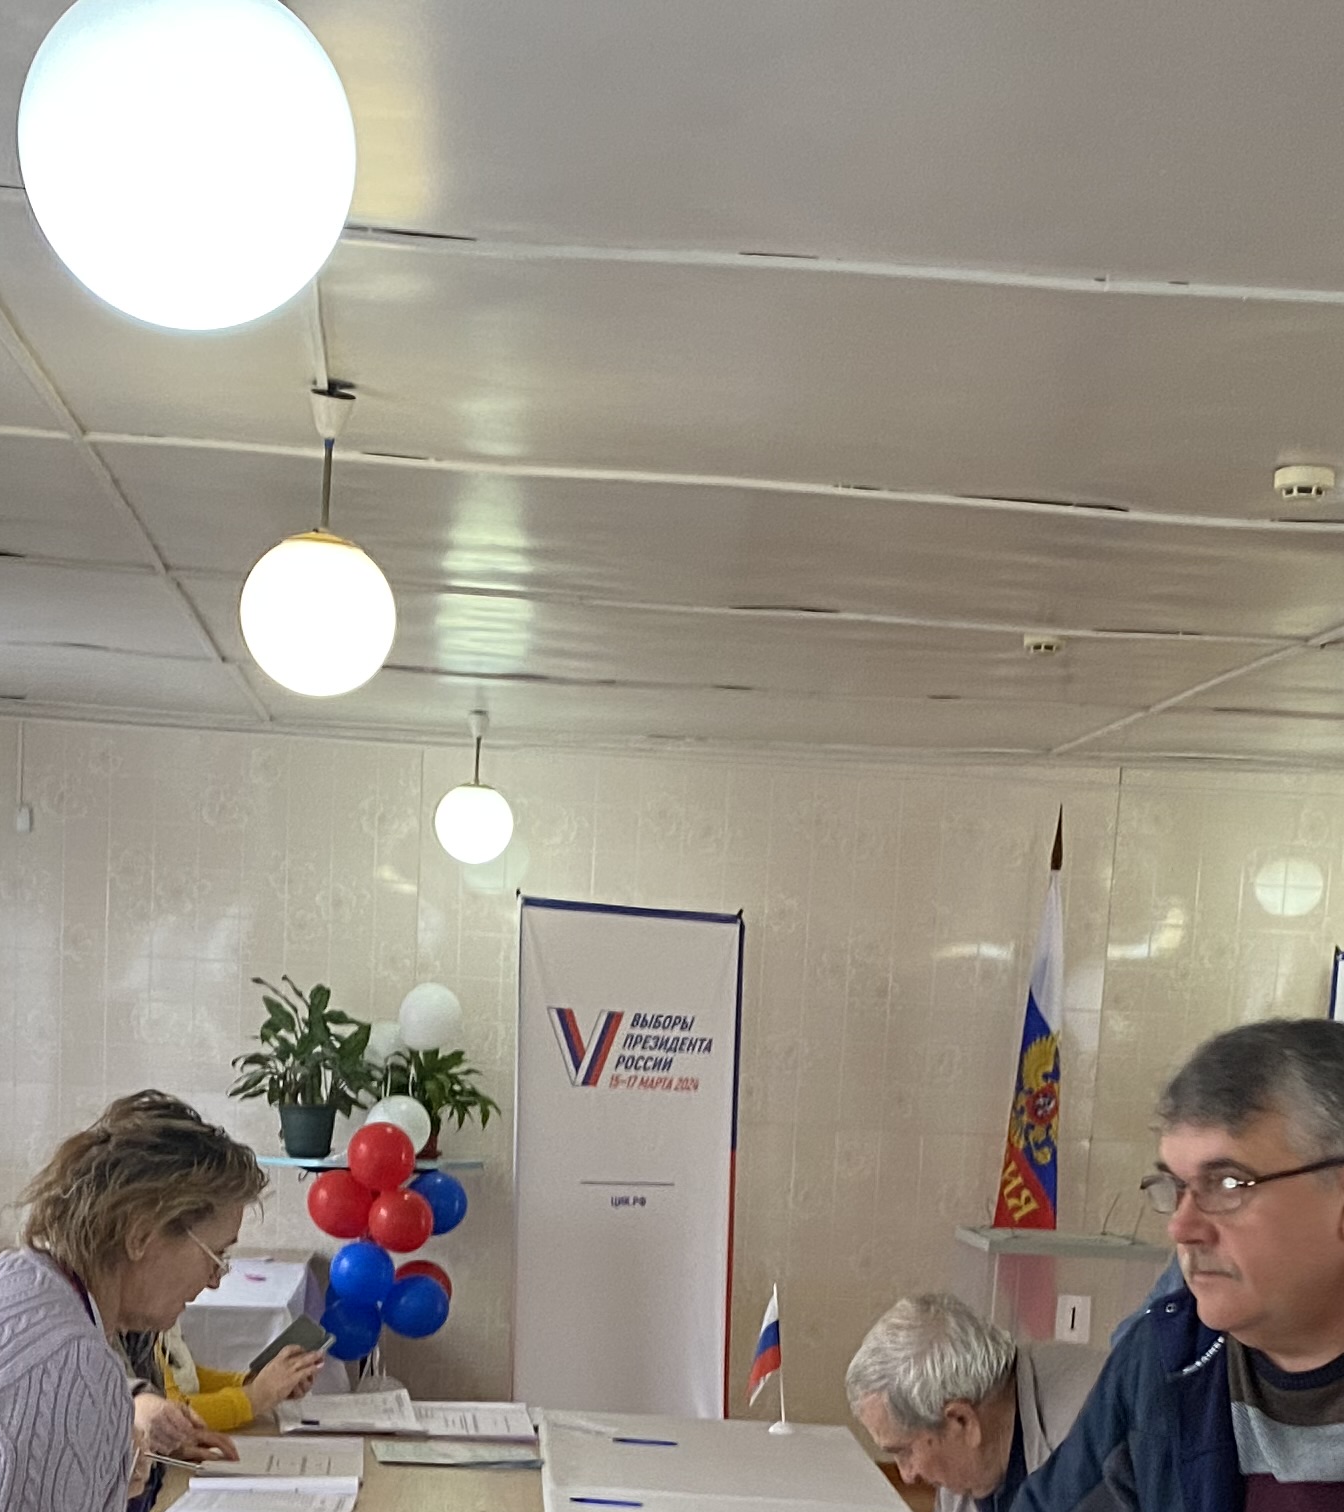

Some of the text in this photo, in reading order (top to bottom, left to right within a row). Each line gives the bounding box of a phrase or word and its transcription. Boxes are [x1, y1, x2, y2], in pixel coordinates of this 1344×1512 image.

[630, 1012, 696, 1032] ВЫБОРЫ
[622, 1033, 713, 1055] ПРЕЗИДЕНТА
[614, 1055, 674, 1073] РОССИИ
[639, 1077, 672, 1091] МАРТА
